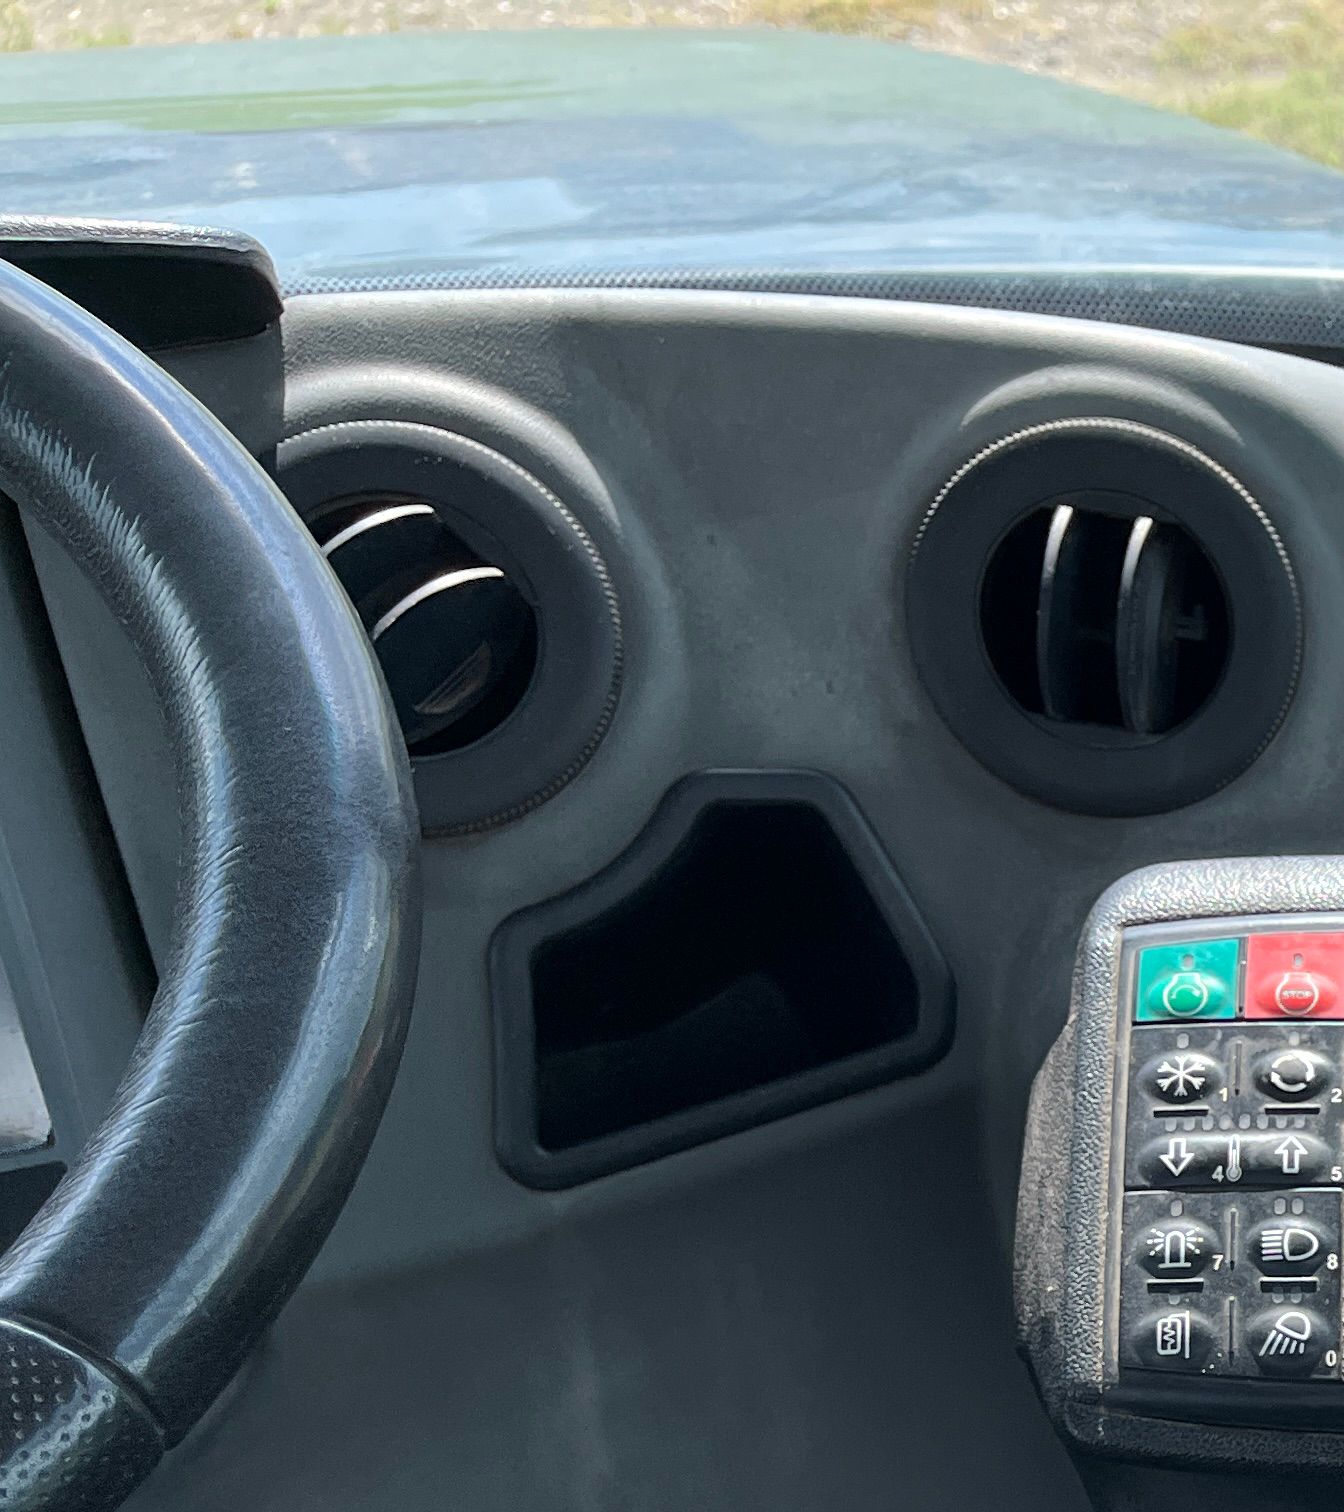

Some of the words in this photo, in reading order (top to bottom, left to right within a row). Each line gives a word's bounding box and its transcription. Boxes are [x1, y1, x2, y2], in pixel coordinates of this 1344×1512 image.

[1219, 1087, 1228, 1102] 1
[1331, 1088, 1343, 1103] 2
[1212, 1165, 1225, 1183] 4
[1331, 1166, 1343, 1182] 5
[1212, 1254, 1224, 1271] 7
[1327, 1254, 1339, 1270] 8
[1325, 1350, 1337, 1367] 0
